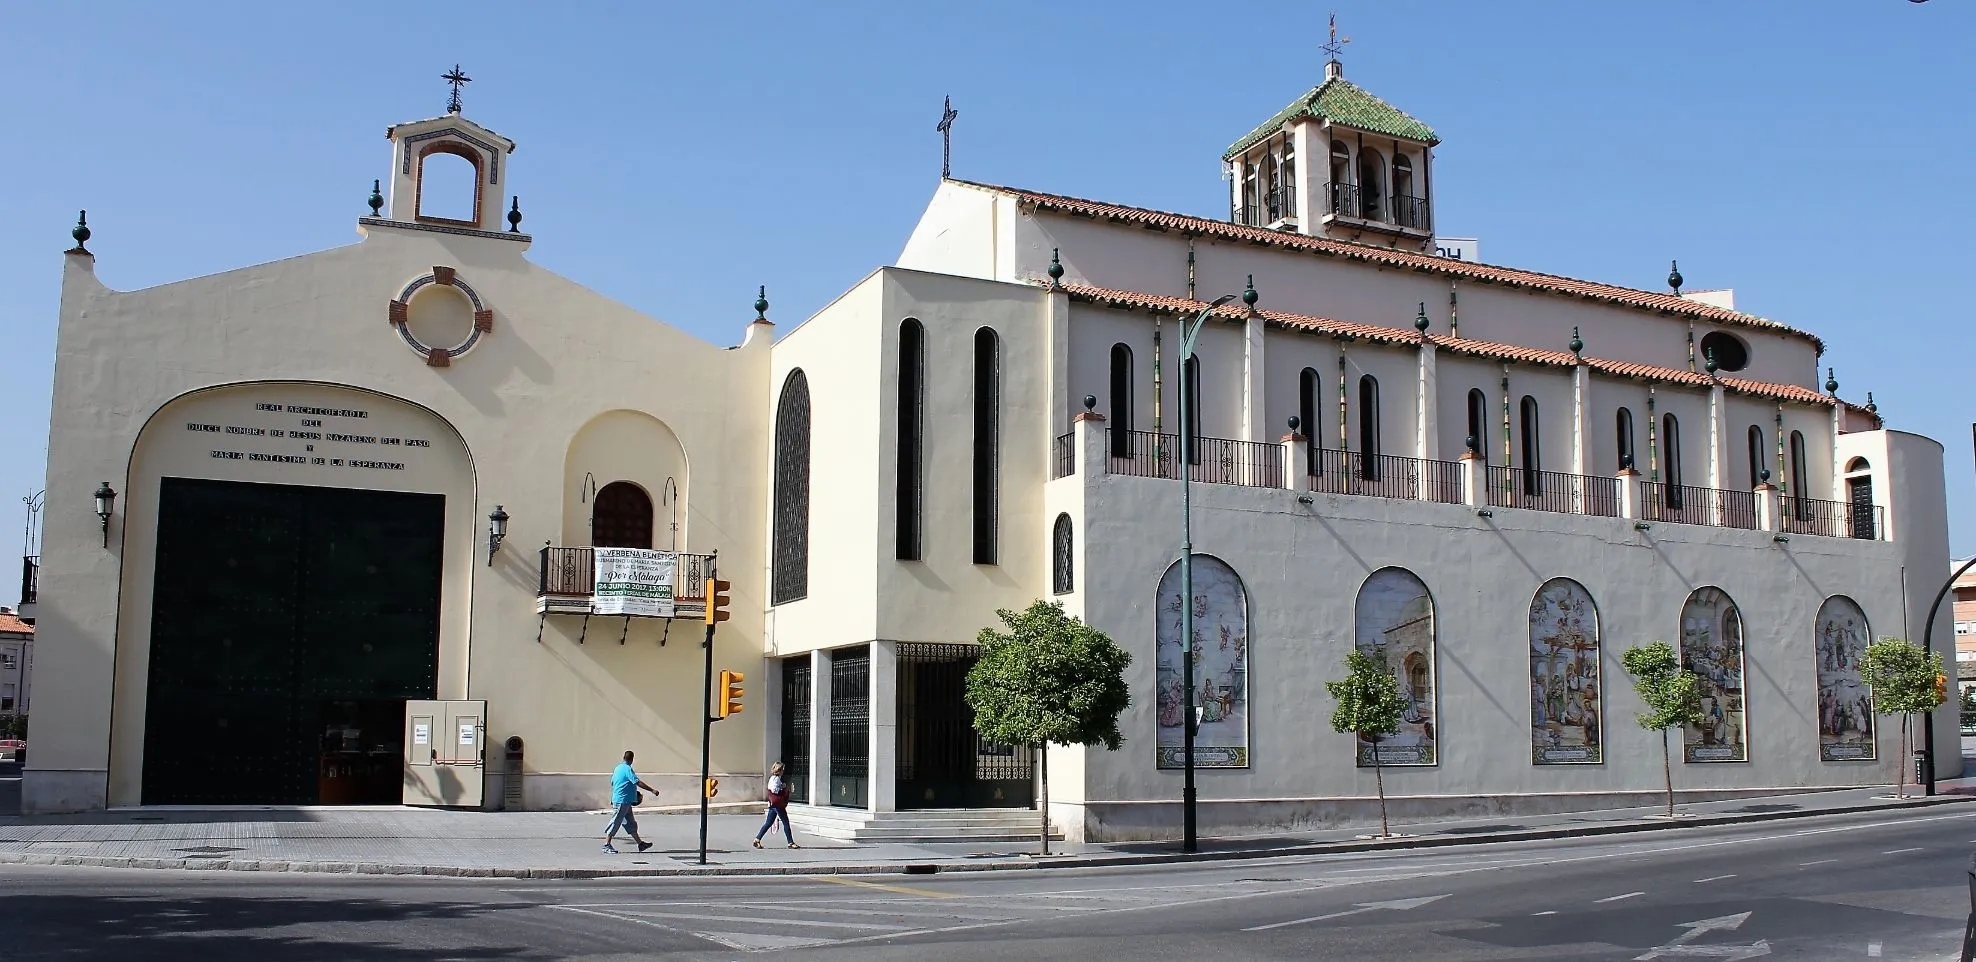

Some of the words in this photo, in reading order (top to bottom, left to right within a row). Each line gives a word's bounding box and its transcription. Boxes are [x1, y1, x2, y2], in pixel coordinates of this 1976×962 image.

[256, 404, 282, 412] REAL
[288, 406, 368, 418] ARCHICOFRADIA
[188, 423, 220, 432] DULCE
[226, 426, 264, 436] NOMBRE
[271, 429, 284, 437] DE
[290, 430, 321, 439] JESUS
[327, 433, 376, 444] NAZARENO
[381, 437, 400, 445] DEL
[405, 439, 430, 447] PASO
[211, 451, 243, 460] MARIA
[249, 453, 306, 464] SANTISIMA
[312, 457, 325, 465] DE
[331, 458, 343, 466] LA
[349, 459, 404, 470] ESPERANZA
